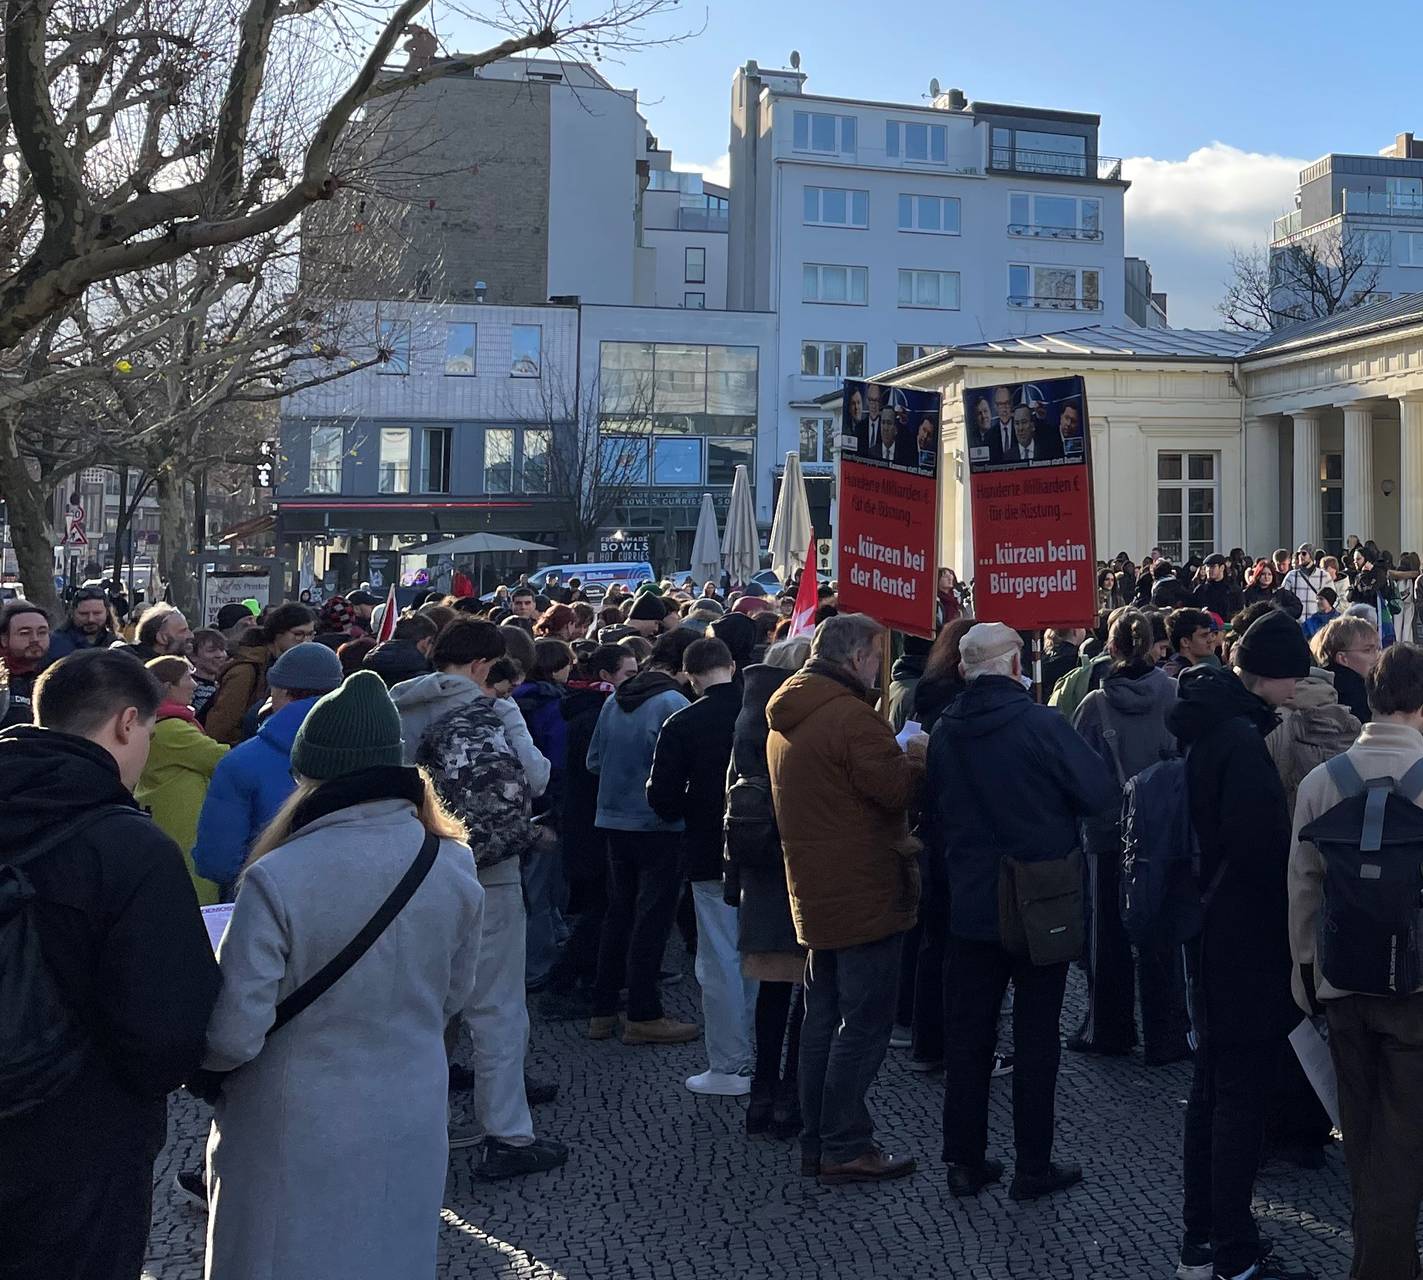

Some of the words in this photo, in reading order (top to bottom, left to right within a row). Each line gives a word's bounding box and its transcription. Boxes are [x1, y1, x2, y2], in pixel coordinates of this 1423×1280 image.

[977, 480, 1020, 499] Hunderte
[1022, 477, 1071, 496] Milliarden
[1073, 475, 1080, 492] €
[989, 504, 1001, 521] für
[1004, 503, 1018, 520] die
[1020, 502, 1061, 522] Rüstung
[600, 542, 649, 552] BOWLS
[600, 551, 614, 561] HOT
[618, 551, 649, 561] CURRIES
[858, 534, 901, 566] kürzen
[904, 545, 925, 572] bei
[995, 542, 1045, 565] kürzen
[1048, 539, 1086, 562] beim
[850, 562, 871, 588] der
[872, 568, 916, 601] Rente!
[990, 569, 1077, 599] Bürgergeld!
